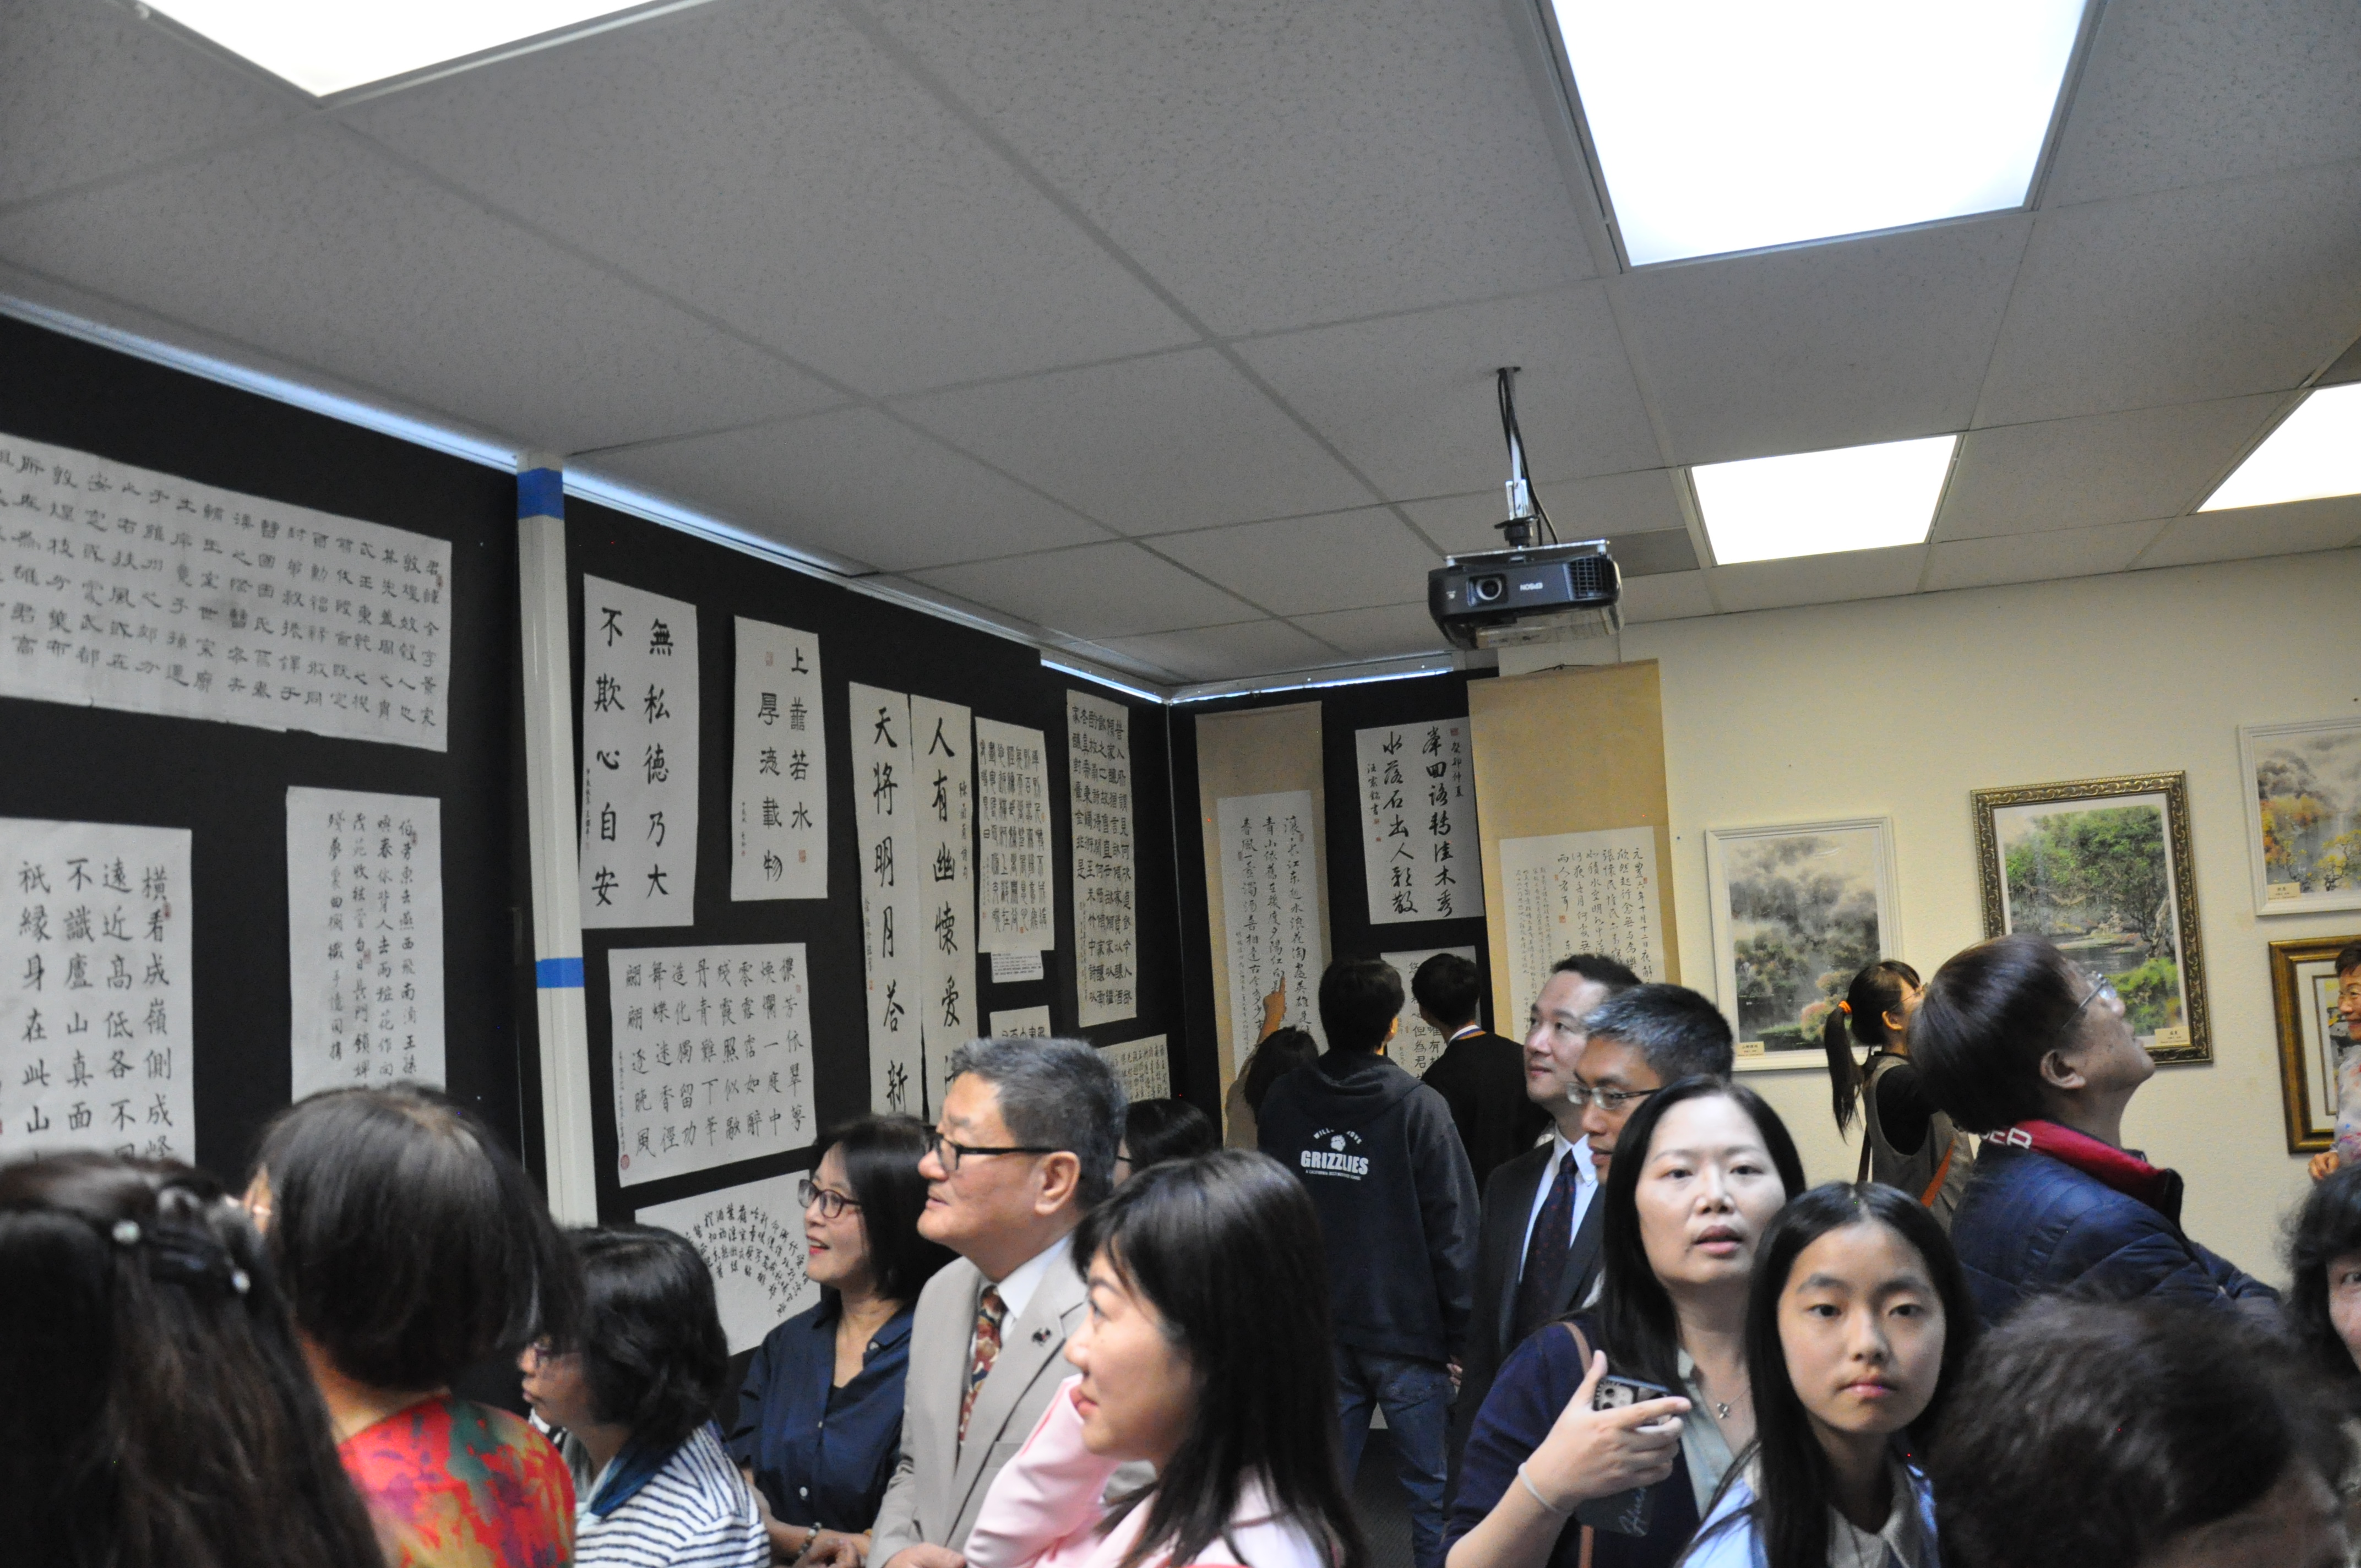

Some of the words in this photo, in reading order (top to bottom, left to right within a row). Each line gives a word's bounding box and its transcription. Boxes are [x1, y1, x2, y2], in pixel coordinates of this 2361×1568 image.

[592, 607, 625, 907] 不欺心自安
[928, 716, 965, 1093] 人有幽懷愛
[1301, 1150, 1369, 1175] GRIZZLIES
